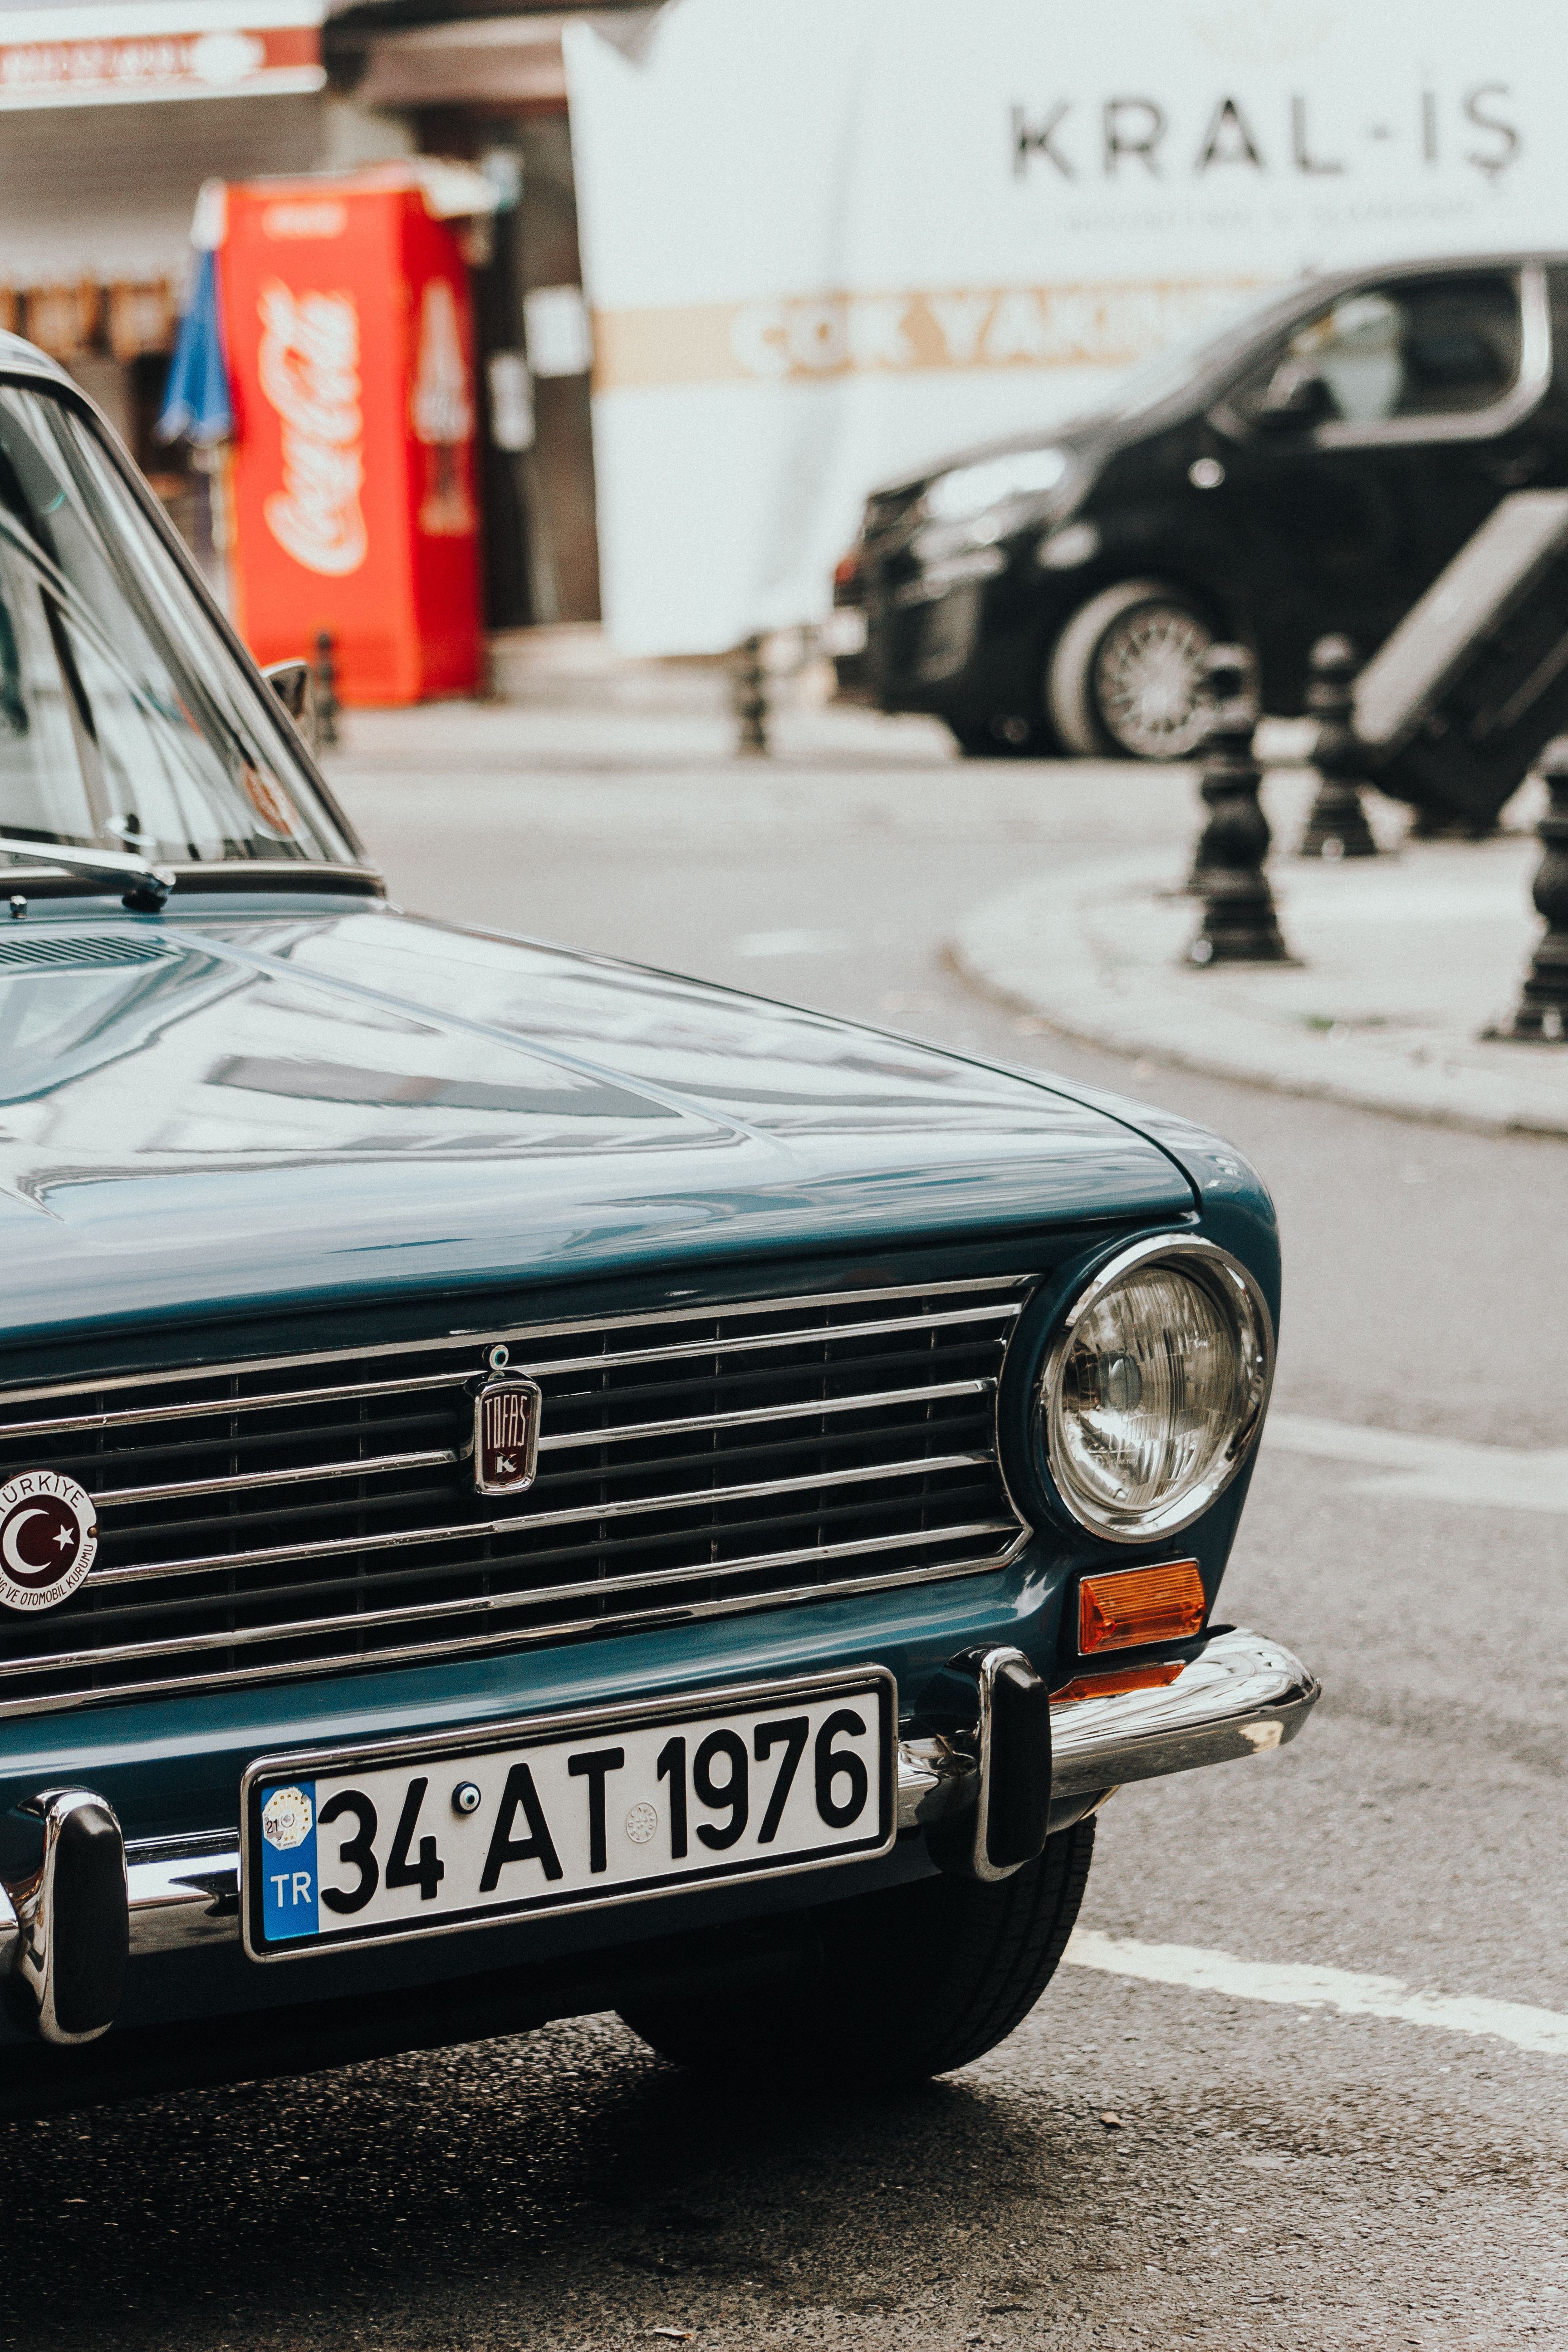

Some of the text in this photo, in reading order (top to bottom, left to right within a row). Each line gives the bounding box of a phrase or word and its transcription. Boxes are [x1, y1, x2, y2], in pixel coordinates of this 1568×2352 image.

[5, 1586, 20, 1602] VE
[20, 1583, 67, 1606] OTOMOBİL
[65, 1544, 93, 1589] KURUMU
[266, 1819, 278, 1834] 21
[318, 1709, 867, 1914] 34 AT 1976
[270, 1871, 312, 1908] TR
